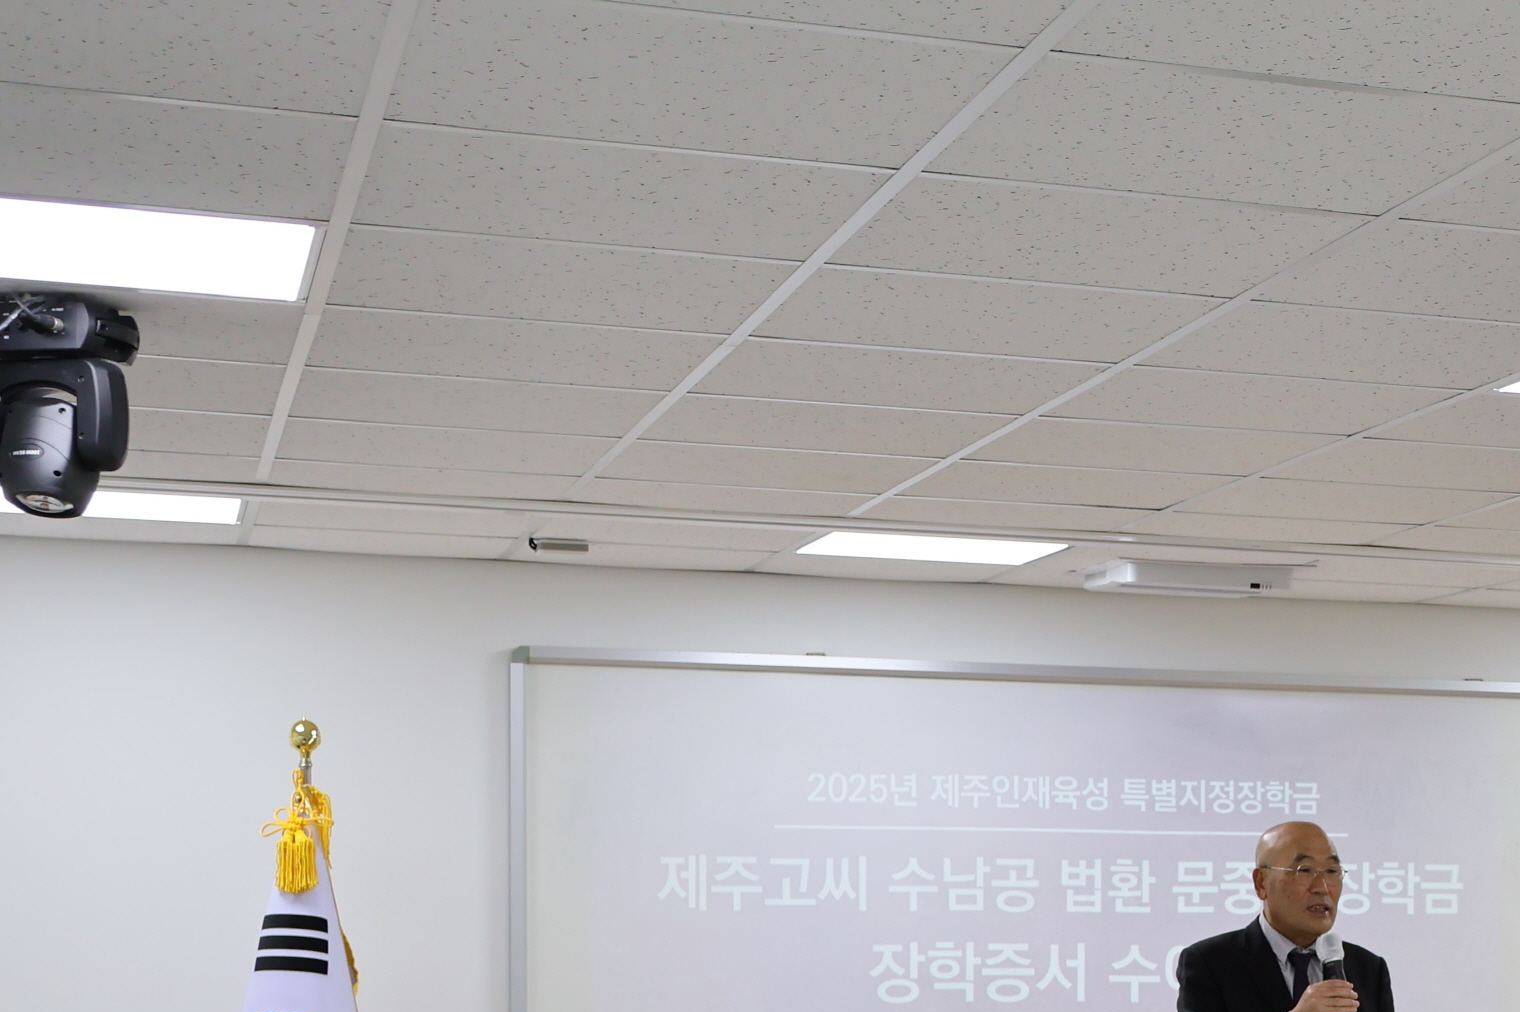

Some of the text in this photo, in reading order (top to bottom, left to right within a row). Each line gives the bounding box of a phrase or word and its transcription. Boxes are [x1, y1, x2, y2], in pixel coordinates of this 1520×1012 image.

[807, 772, 1320, 815] 2025년 제주인재육성 특별지정장학금
[657, 854, 867, 911] 제주고씨
[888, 857, 1040, 913] 수남공
[1061, 858, 1156, 913] 법환
[1172, 861, 1261, 915] 문중
[869, 941, 1085, 1003] 장학증서
